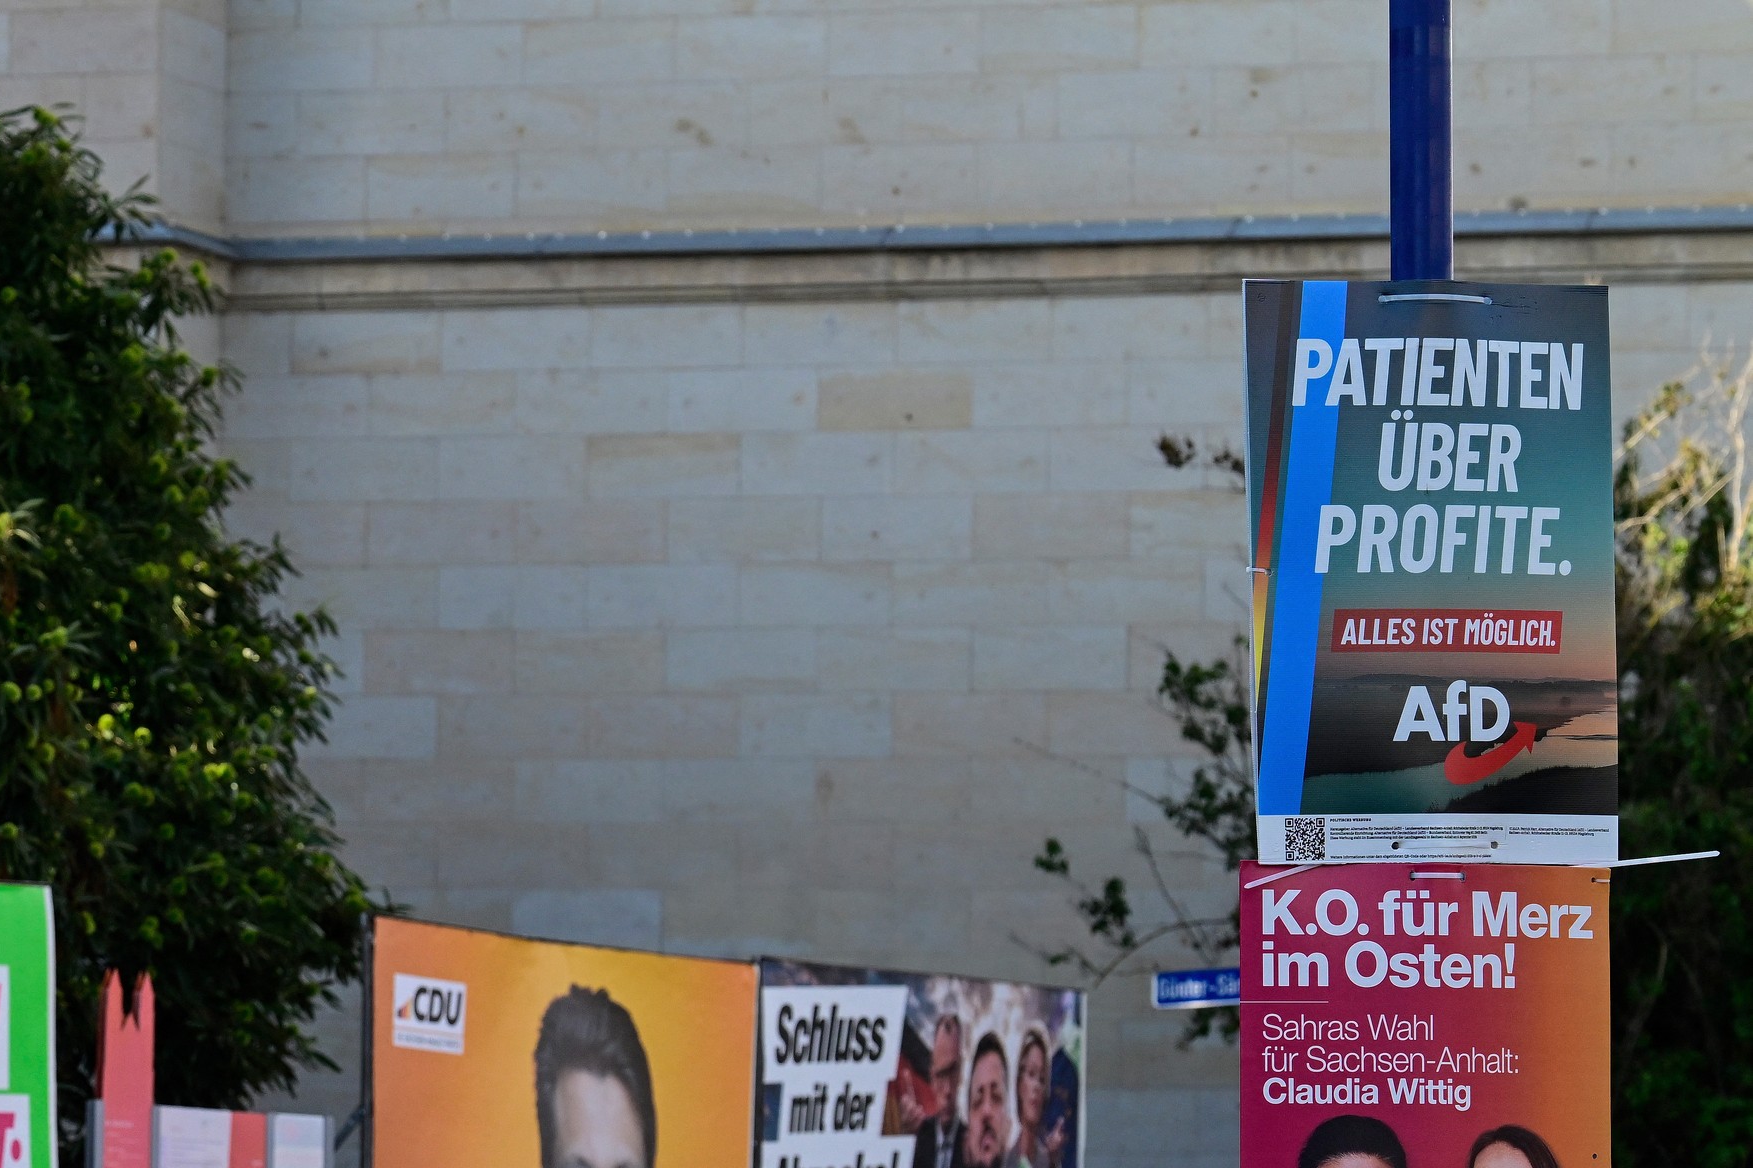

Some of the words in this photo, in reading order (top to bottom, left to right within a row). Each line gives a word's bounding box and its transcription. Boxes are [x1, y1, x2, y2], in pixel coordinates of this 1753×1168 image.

[1292, 337, 1584, 411] PATIENTEN
[1378, 410, 1522, 493] ÜBER
[1314, 504, 1572, 576] PROFITE.
[1340, 617, 1416, 646] ALLES
[1421, 618, 1459, 646] IST
[1463, 612, 1556, 647] MÖGLICH.
[1392, 680, 1510, 743] AfD
[1261, 889, 1369, 936] K.O.
[1378, 889, 1458, 938] für
[1472, 891, 1594, 940] Merz
[1261, 943, 1329, 987] im
[1345, 942, 1516, 989] Osten!
[414, 987, 462, 1025] CDU
[1262, 1013, 1360, 1041] Sahras
[1367, 1014, 1434, 1042] Wahl
[775, 1004, 885, 1065] Schluss
[1261, 1045, 1300, 1073] für
[1306, 1046, 1519, 1075] Sachsen-Anhalt:
[788, 1083, 826, 1132] mit
[834, 1084, 873, 1131] der
[1263, 1077, 1379, 1105] Claudia
[1387, 1078, 1471, 1111] Wittig
